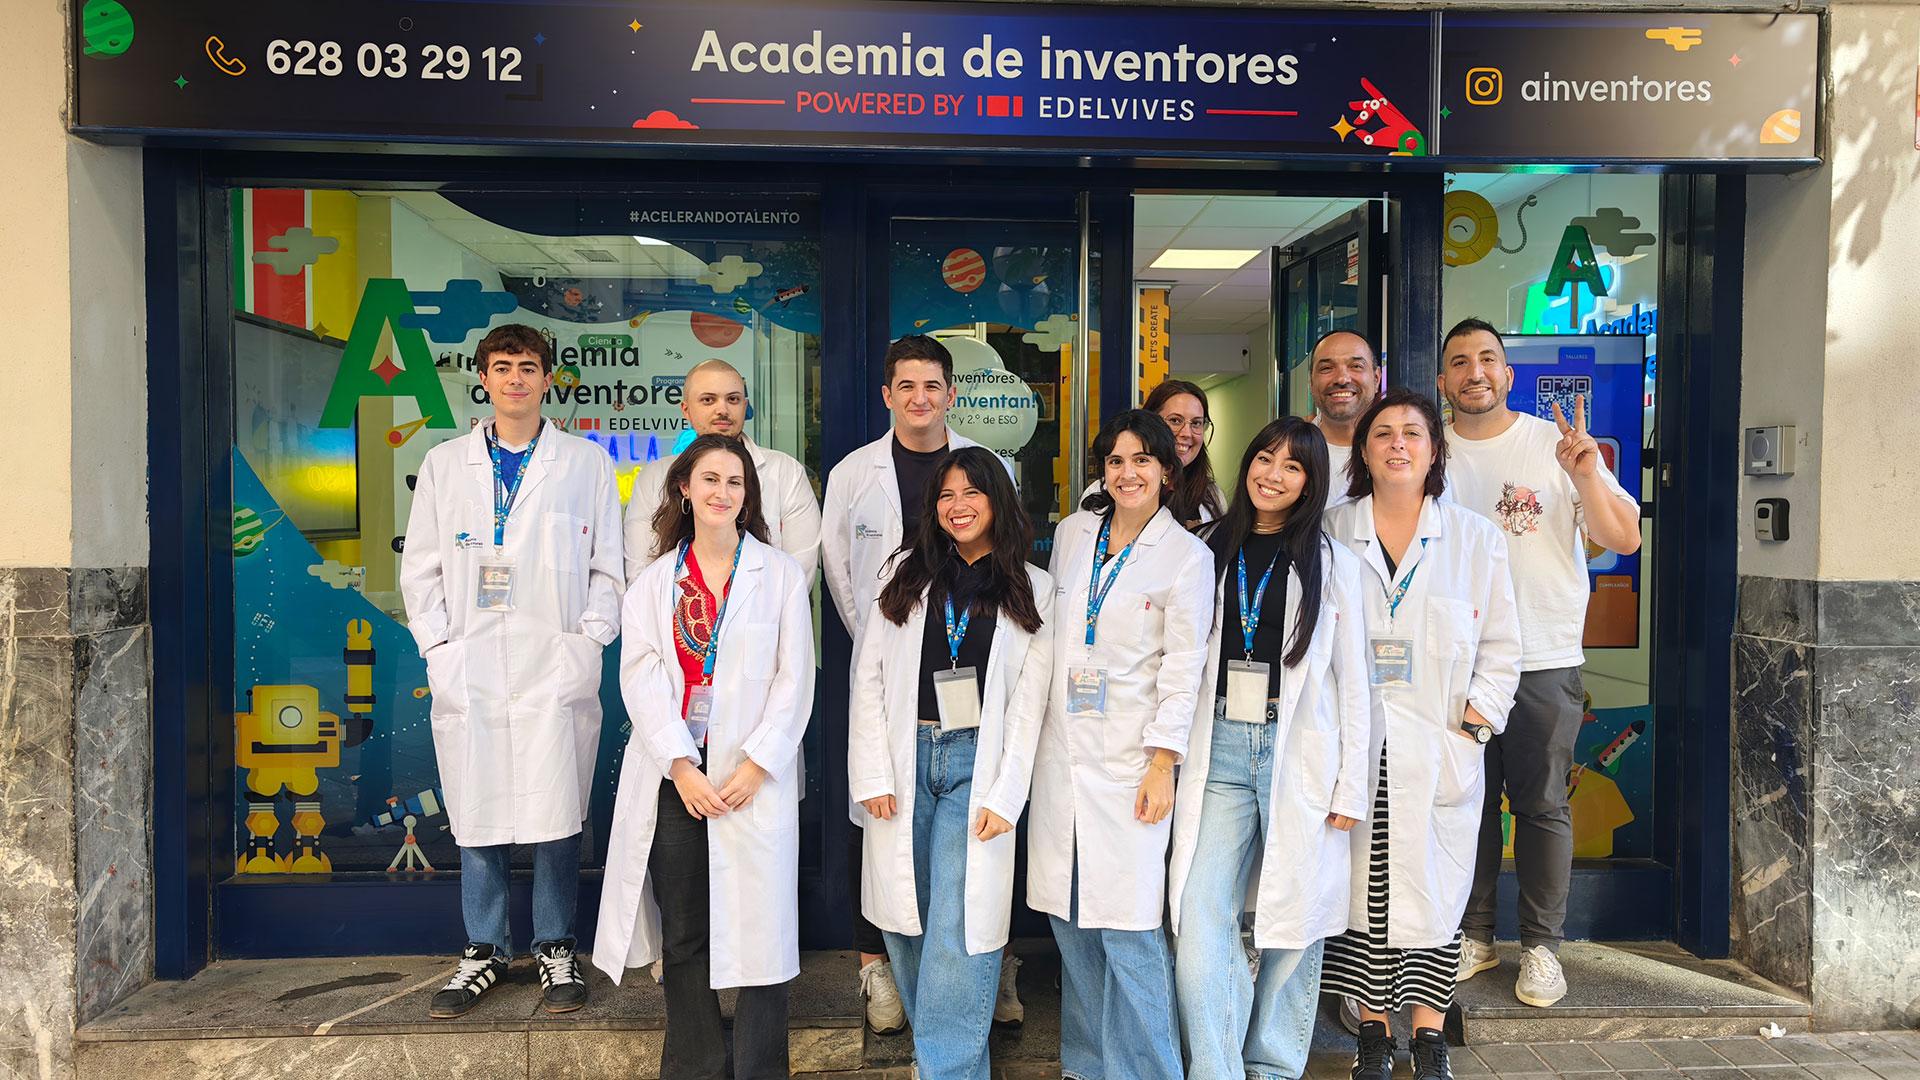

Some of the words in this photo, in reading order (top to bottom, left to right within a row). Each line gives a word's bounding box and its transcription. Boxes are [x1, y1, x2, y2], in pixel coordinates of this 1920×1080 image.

[266, 39, 343, 76] 628
[357, 42, 407, 78] 03
[421, 45, 470, 80] 29
[482, 46, 522, 81] 12
[690, 30, 946, 77] Academia
[962, 33, 1023, 79] de
[1041, 35, 1299, 85] inventores
[1521, 71, 1712, 102] ainventores
[797, 91, 925, 116] POWERED
[934, 94, 964, 116] BY
[1039, 96, 1195, 121] EDELVIVES
[629, 210, 800, 224] #ACELERANDOTALENTO
[1150, 304, 1158, 336] CREATE
[1150, 339, 1158, 363] LET'S
[952, 371, 1015, 384] nventores
[609, 417, 690, 431] EDELVIVE
[959, 416, 965, 426] y
[983, 415, 996, 425] de
[998, 415, 1018, 425] ESO
